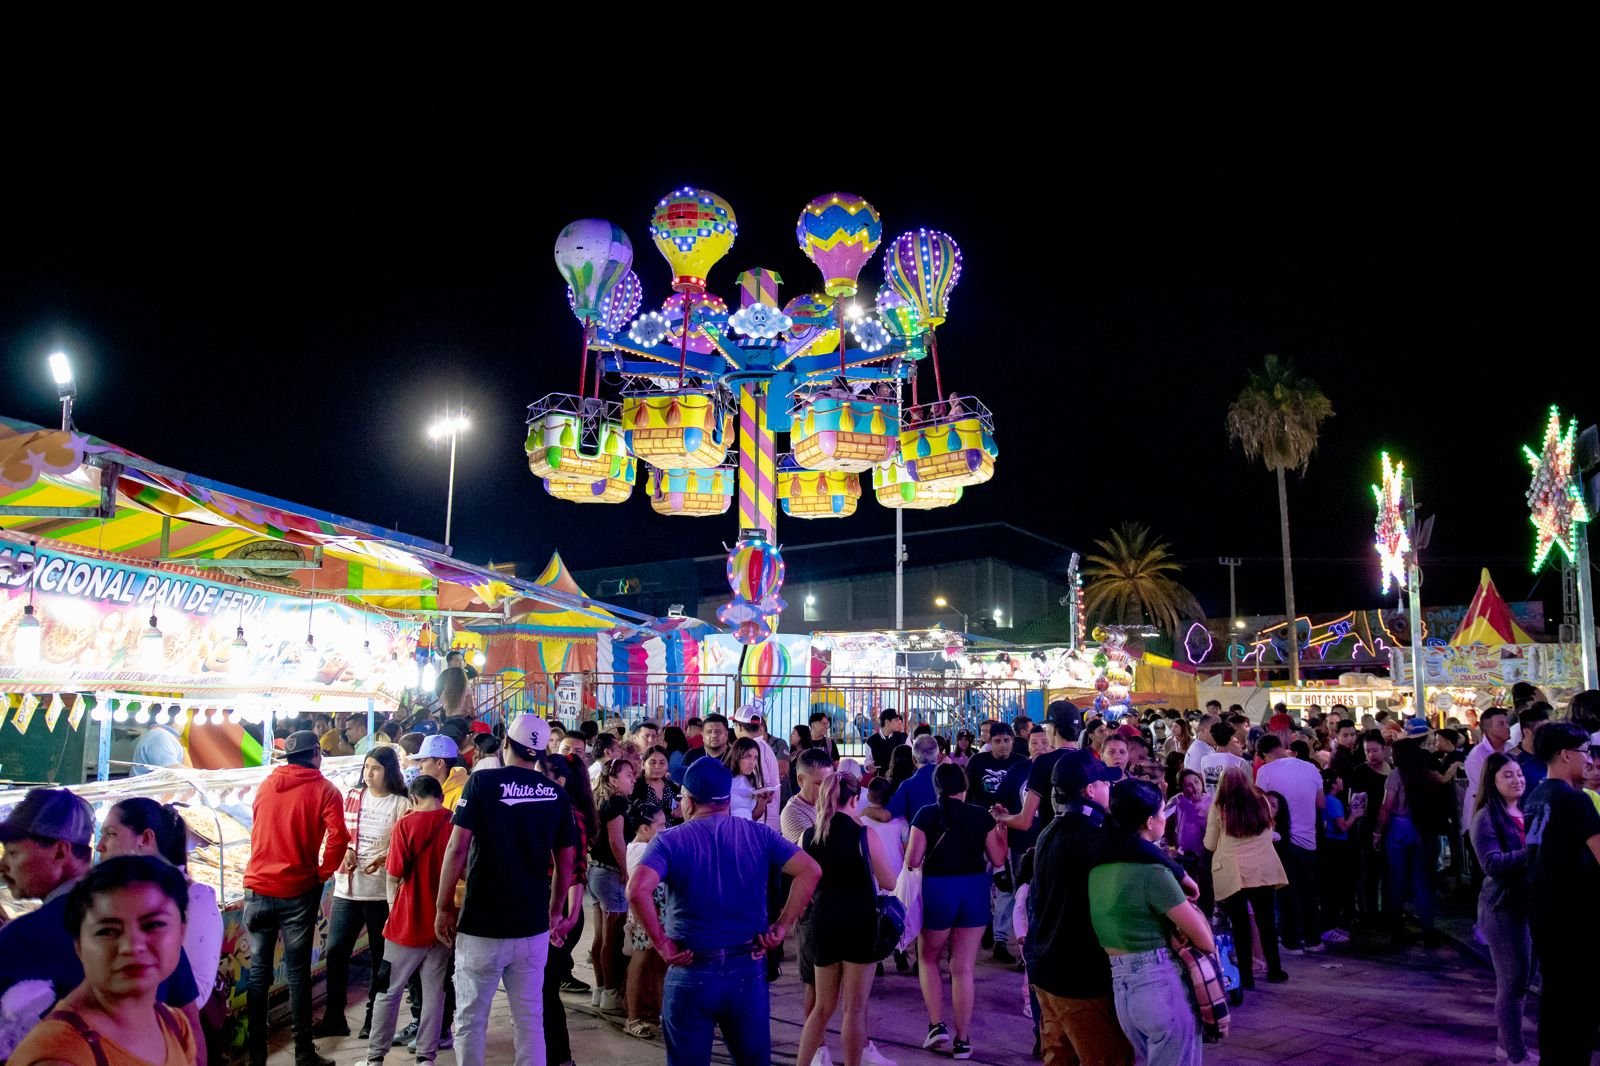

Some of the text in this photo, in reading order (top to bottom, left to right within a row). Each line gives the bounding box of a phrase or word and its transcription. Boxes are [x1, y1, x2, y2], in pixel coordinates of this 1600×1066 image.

[138, 576, 189, 608] PAN
[183, 583, 219, 613] DE
[213, 589, 268, 617] FERIA
[1305, 695, 1354, 705] HOT CAKES
[500, 781, 558, 799] White Sox
